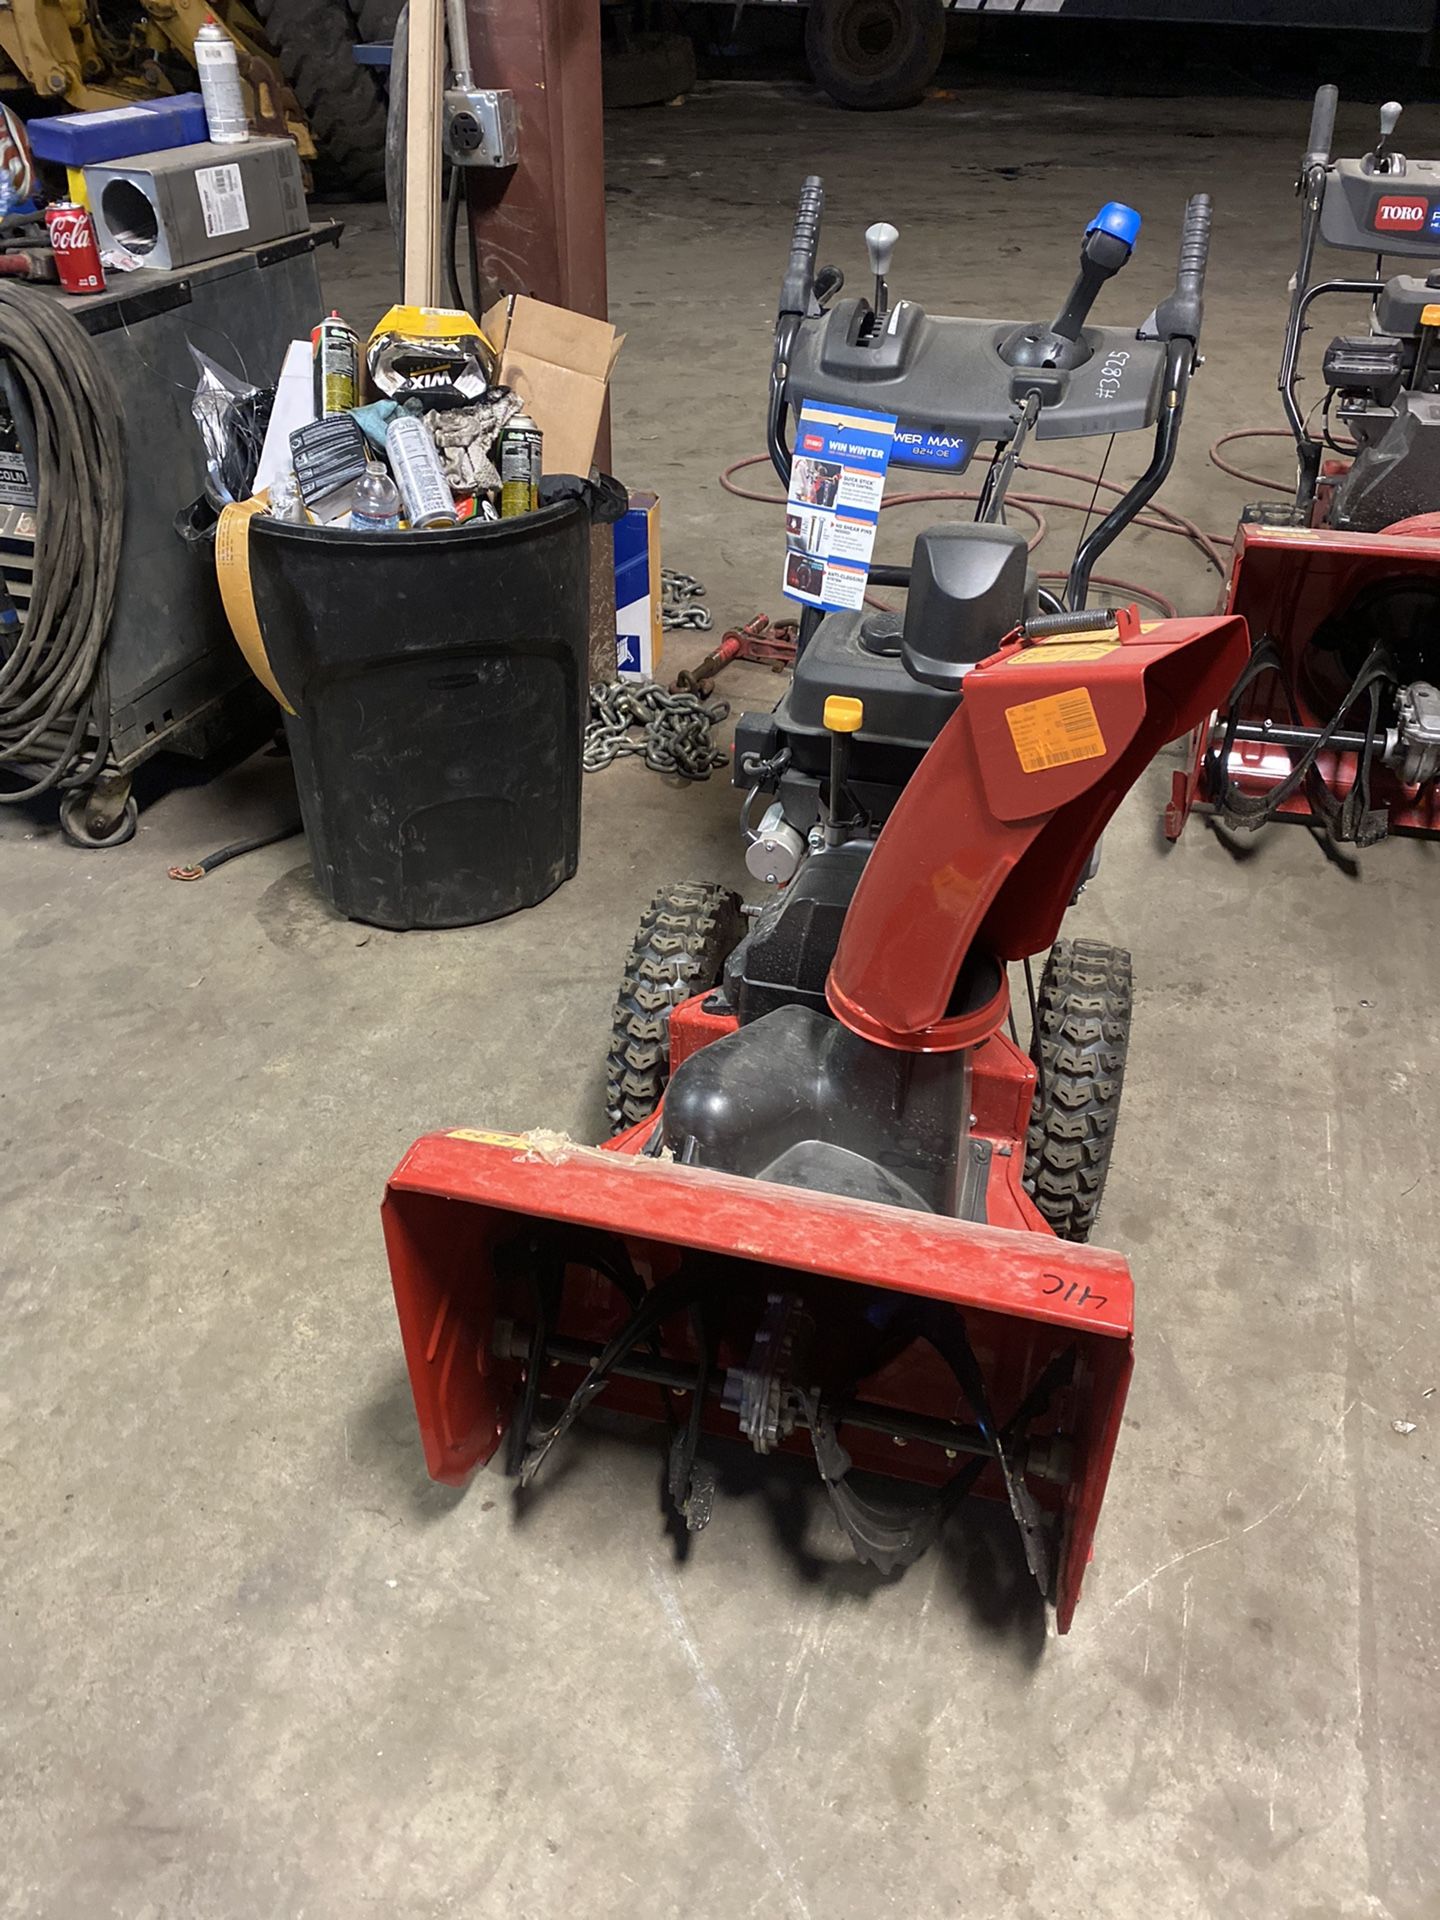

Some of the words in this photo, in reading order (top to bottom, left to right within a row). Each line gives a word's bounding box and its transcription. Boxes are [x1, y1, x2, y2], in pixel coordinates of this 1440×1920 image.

[1381, 206, 1424, 220] TORO
[50, 215, 89, 249] Cola
[410, 371, 452, 390] WIX
[1095, 351, 1130, 398] #3825
[893, 432, 923, 445] WER
[927, 436, 959, 448] MAX
[829, 440, 848, 452] WIN
[848, 444, 885, 459] WINTER
[912, 447, 933, 455] 824
[935, 449, 950, 457] OE
[0, 470, 25, 482] COLN
[859, 478, 873, 486] STICK
